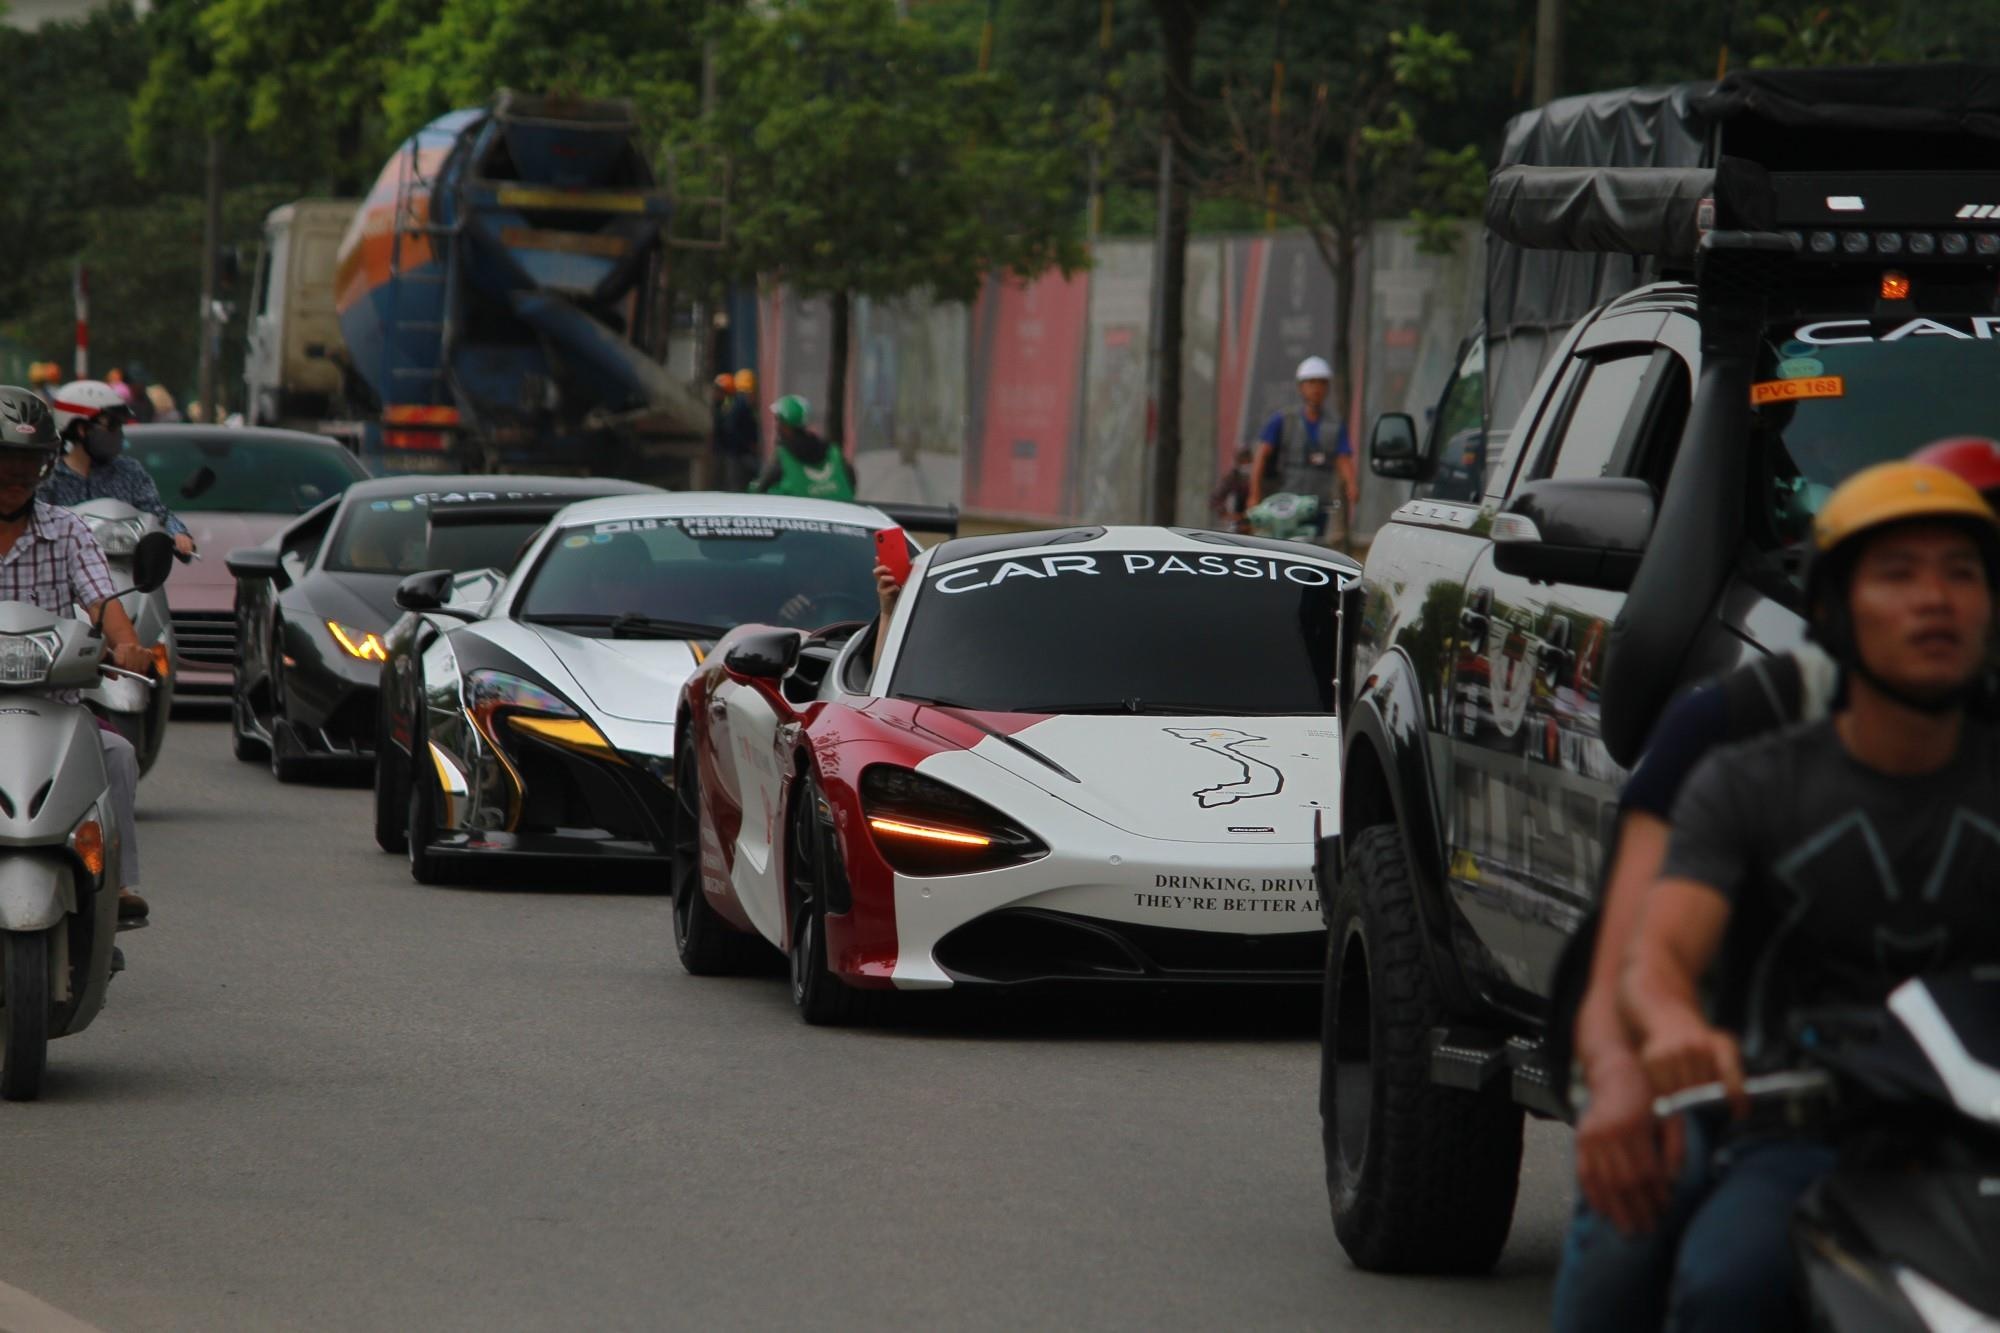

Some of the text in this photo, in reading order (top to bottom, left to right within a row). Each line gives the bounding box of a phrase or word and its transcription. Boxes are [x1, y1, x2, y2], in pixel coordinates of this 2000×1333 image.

[1757, 380, 1837, 400] PVC 168
[683, 517, 831, 534] PERFORMANCE
[935, 555, 1101, 594] CAR
[1155, 874, 1318, 893] DRINKING, DRIVI
[1134, 893, 1217, 911] THEY'RE
[1223, 898, 1297, 912] BETTER
